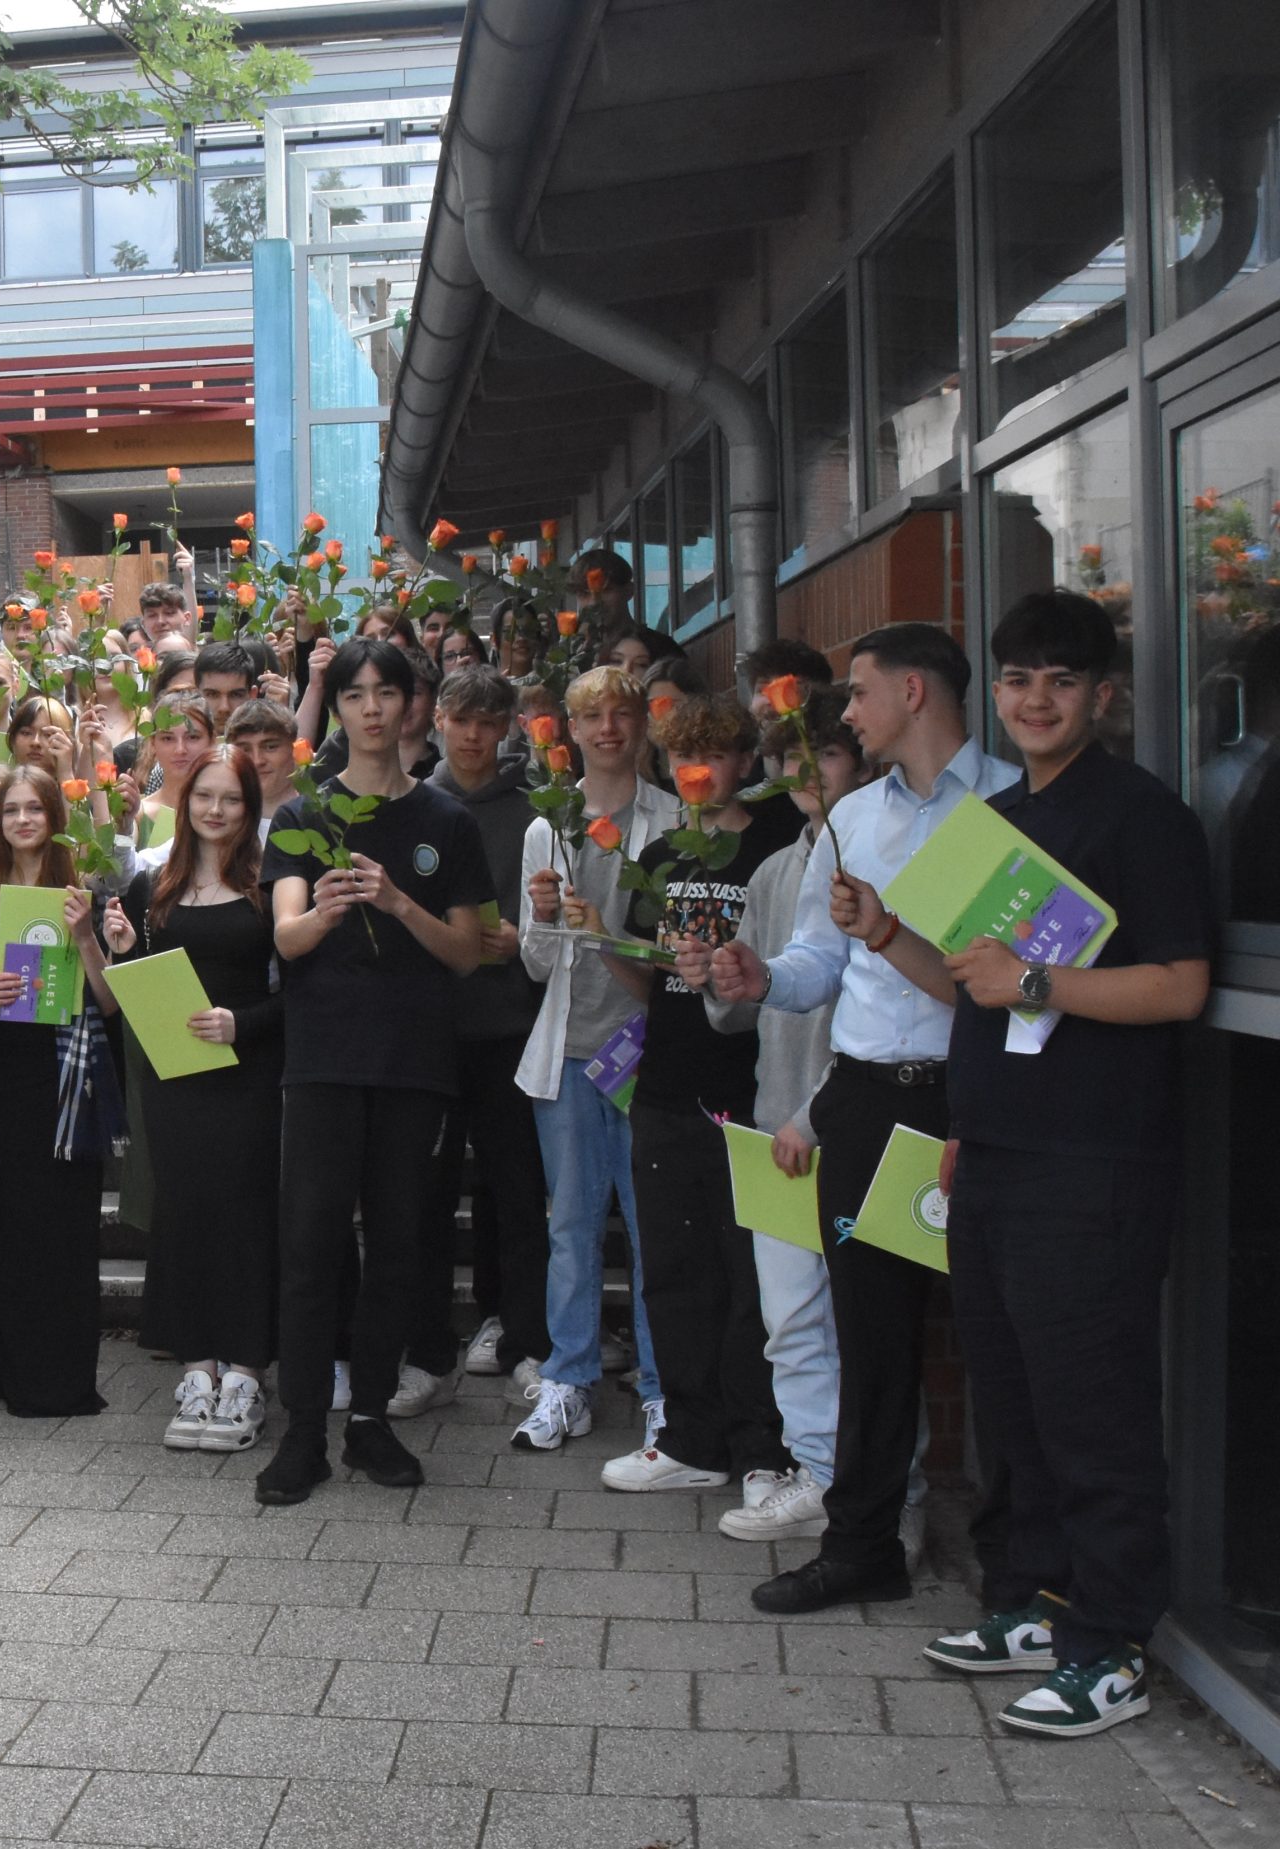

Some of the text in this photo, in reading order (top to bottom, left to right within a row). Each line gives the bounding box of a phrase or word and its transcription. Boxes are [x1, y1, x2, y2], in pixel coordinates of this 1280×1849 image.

[984, 888, 1031, 938] LLES
[1021, 919, 1062, 962] UTE
[45, 964, 58, 1007] ALLES
[665, 975, 697, 993] 202
